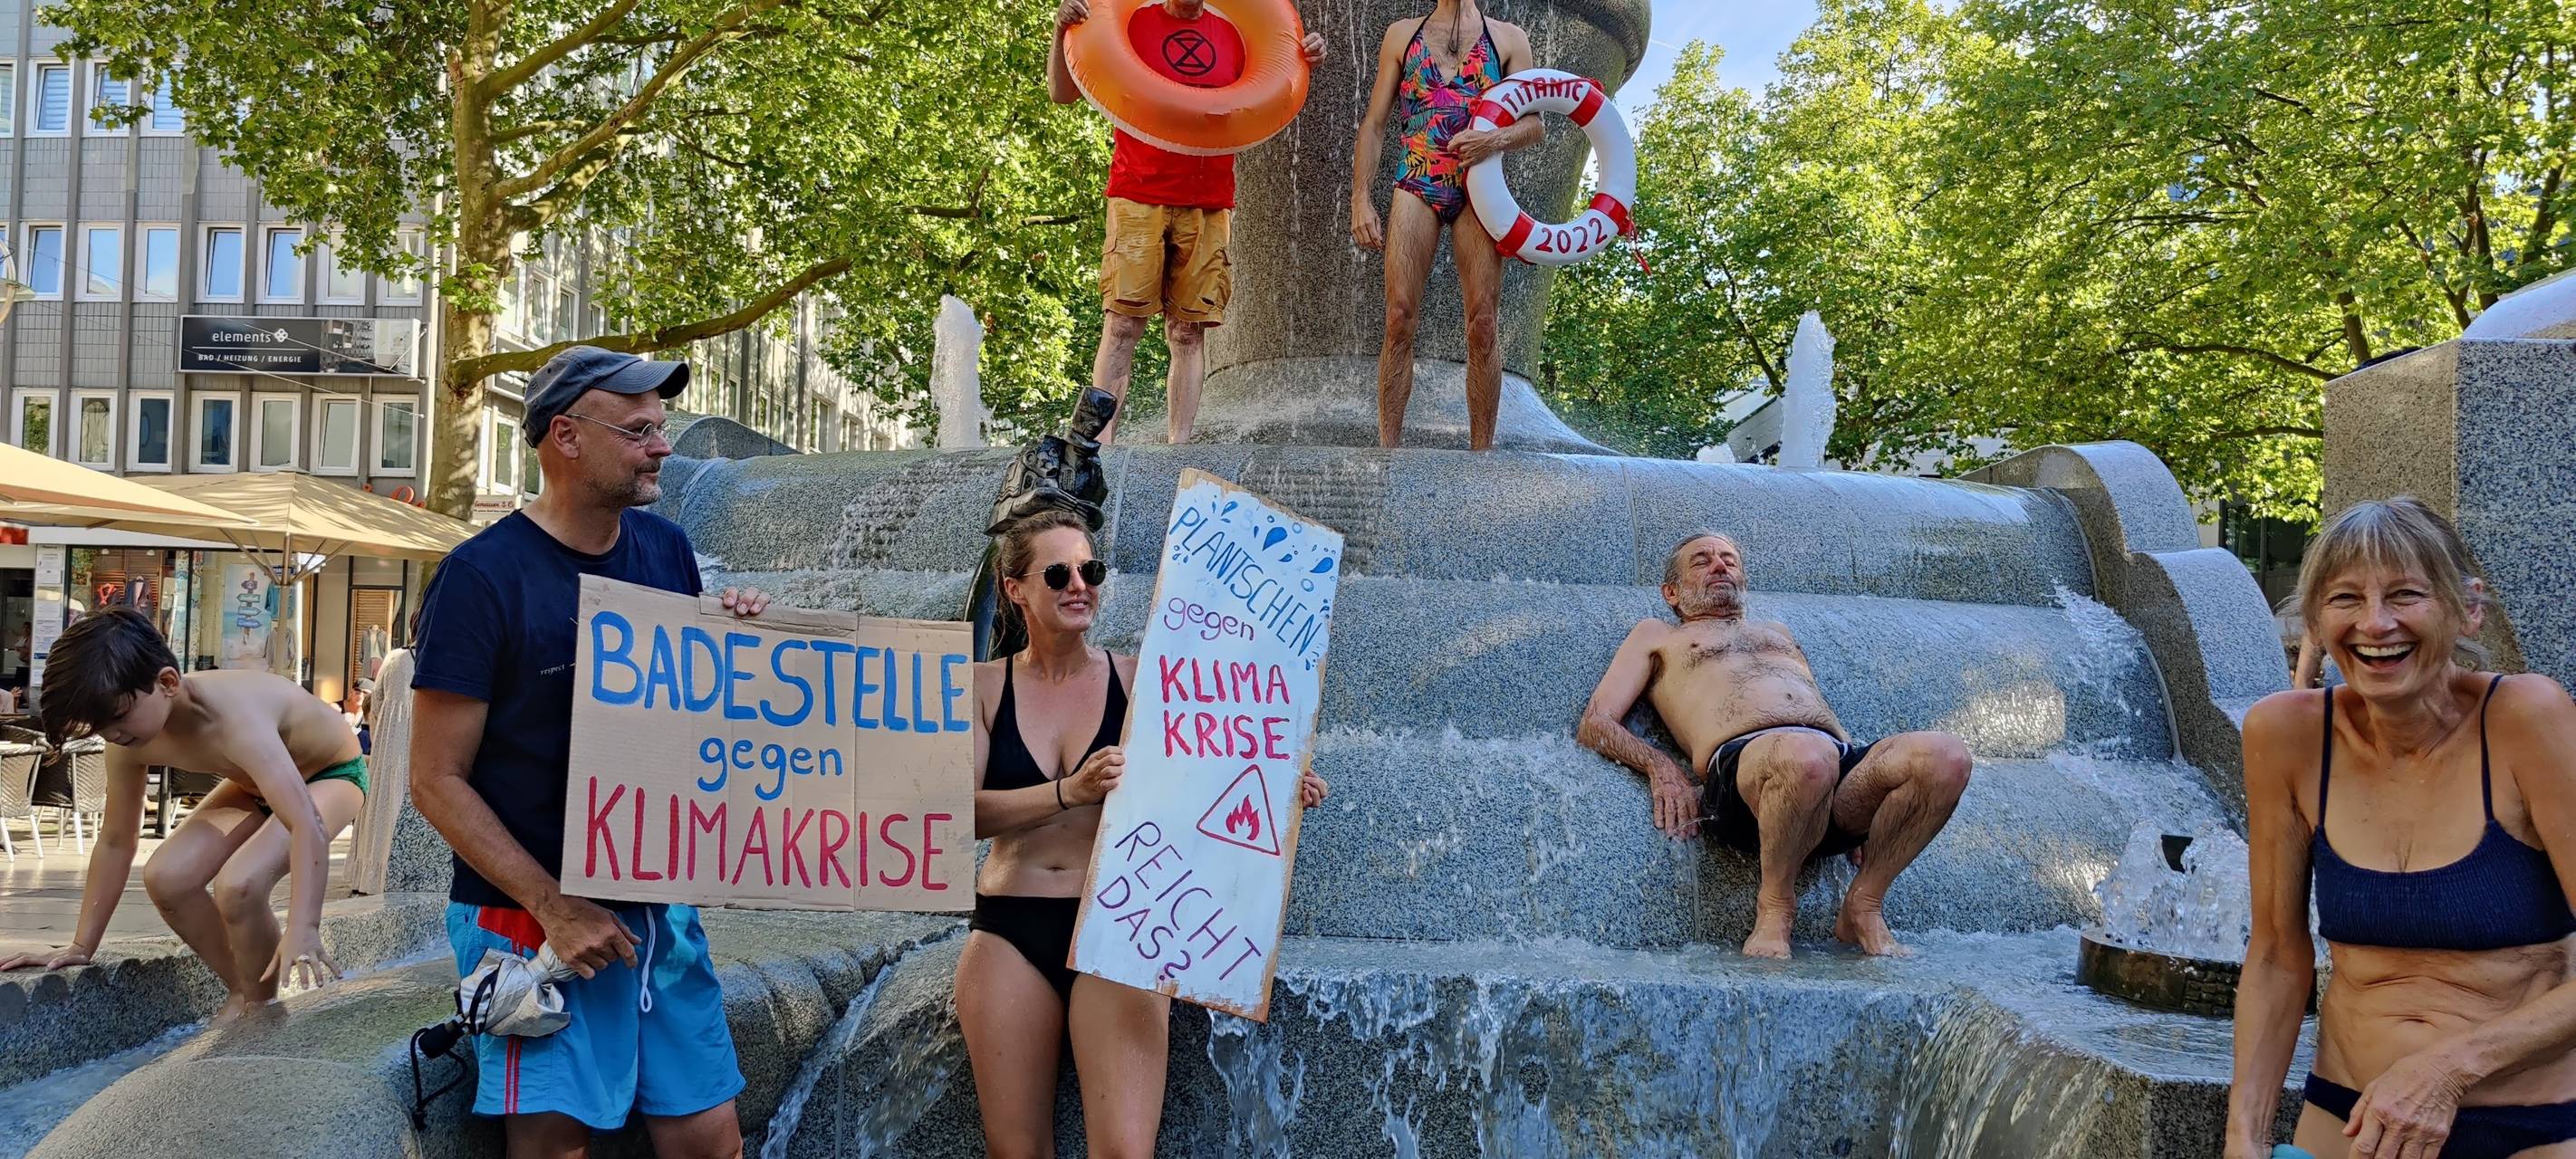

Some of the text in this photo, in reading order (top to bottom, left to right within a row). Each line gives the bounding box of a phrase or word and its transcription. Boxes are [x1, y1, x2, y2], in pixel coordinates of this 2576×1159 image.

[1501, 77, 1584, 114] TITANIC
[1534, 217, 1608, 254] 2022
[197, 353, 215, 361] BAD
[224, 354, 259, 363] HEIZUNG
[268, 355, 303, 364] ENERGIE
[211, 330, 272, 343] elements
[1168, 506, 1322, 657] PLANTSCHEN
[1164, 597, 1254, 641] gegen
[591, 610, 971, 733] BADESTELLE
[1159, 654, 1291, 704] KLIMA
[1163, 709, 1291, 761] KRISE
[697, 736, 843, 801] gegen
[584, 775, 953, 891] KLIMAKRISE
[1114, 820, 1262, 981] REICHT
[1096, 875, 1191, 982] DAS?
